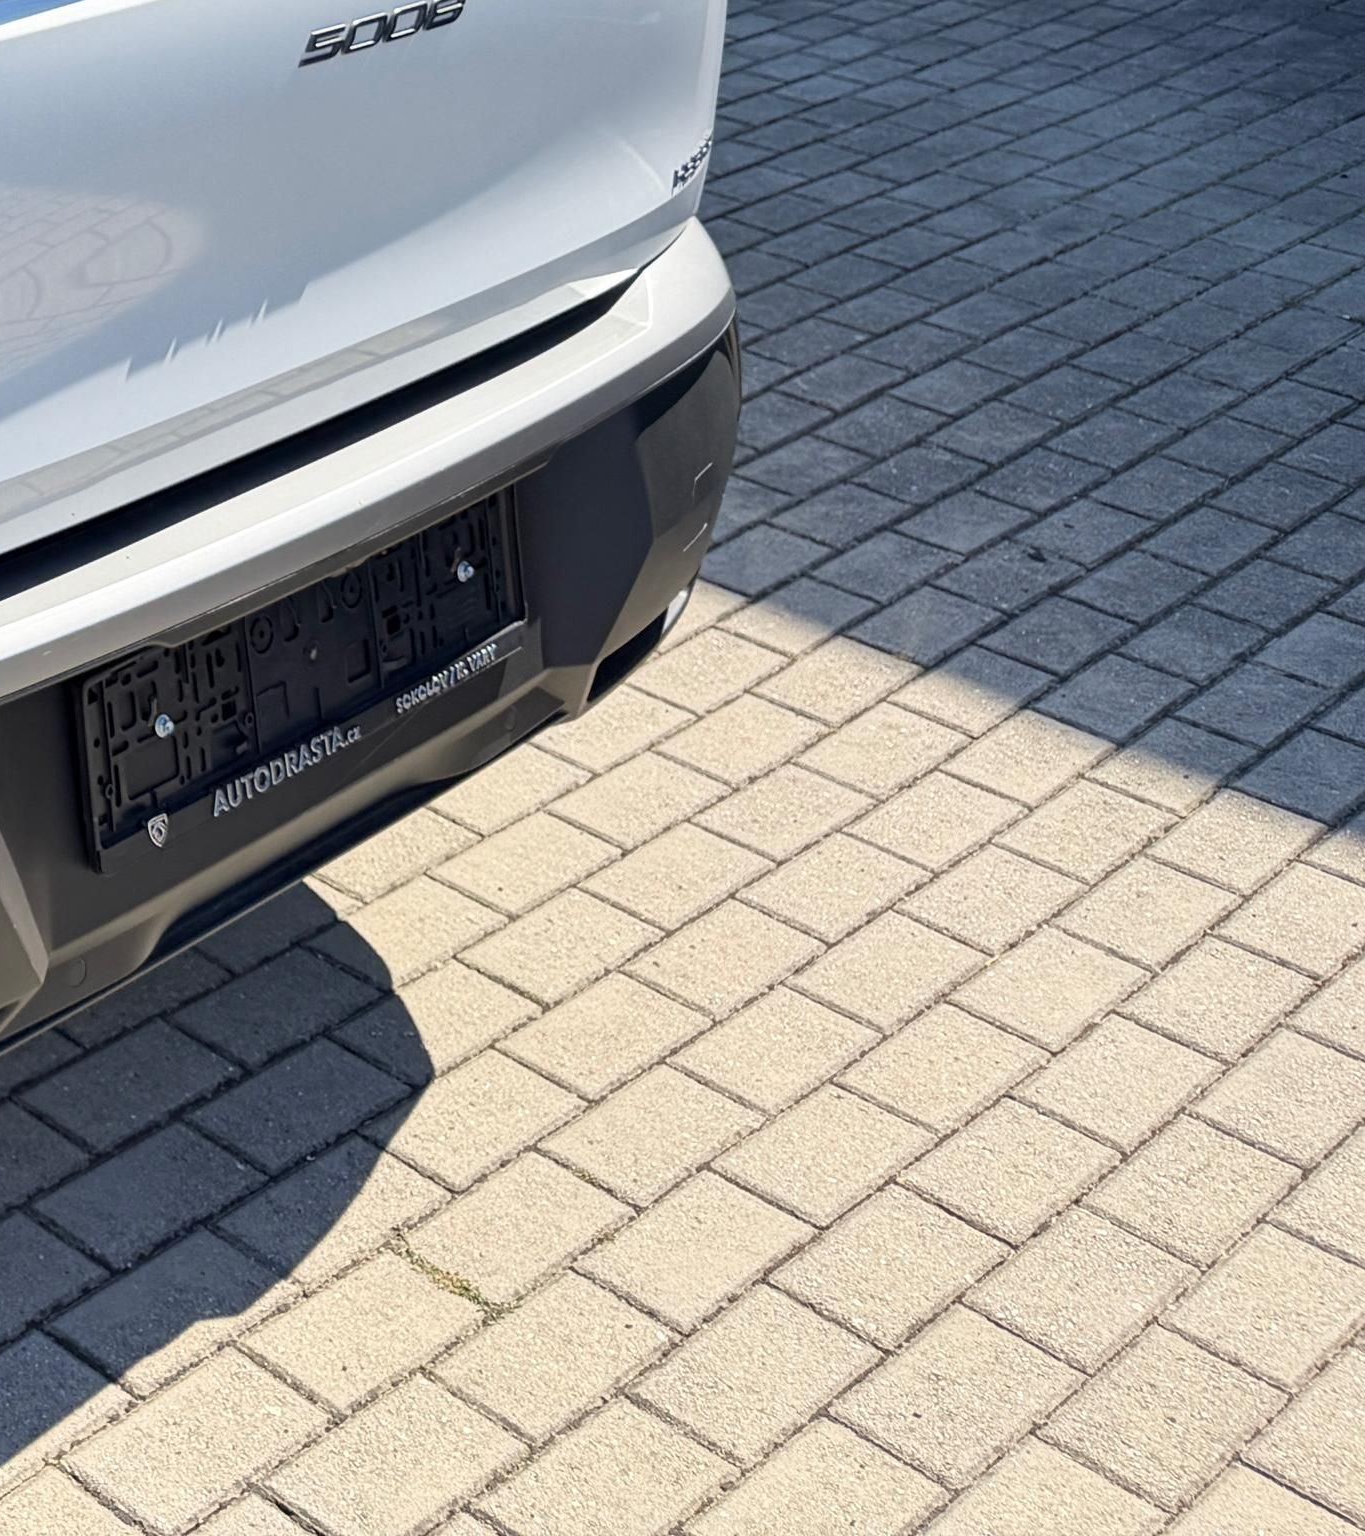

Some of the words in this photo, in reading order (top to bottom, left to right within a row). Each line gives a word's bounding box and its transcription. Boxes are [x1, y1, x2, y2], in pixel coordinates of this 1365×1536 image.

[396, 670, 450, 714] SOKOLOV
[466, 643, 497, 672] VARY
[212, 725, 362, 818] AUTODRASTA.cz
